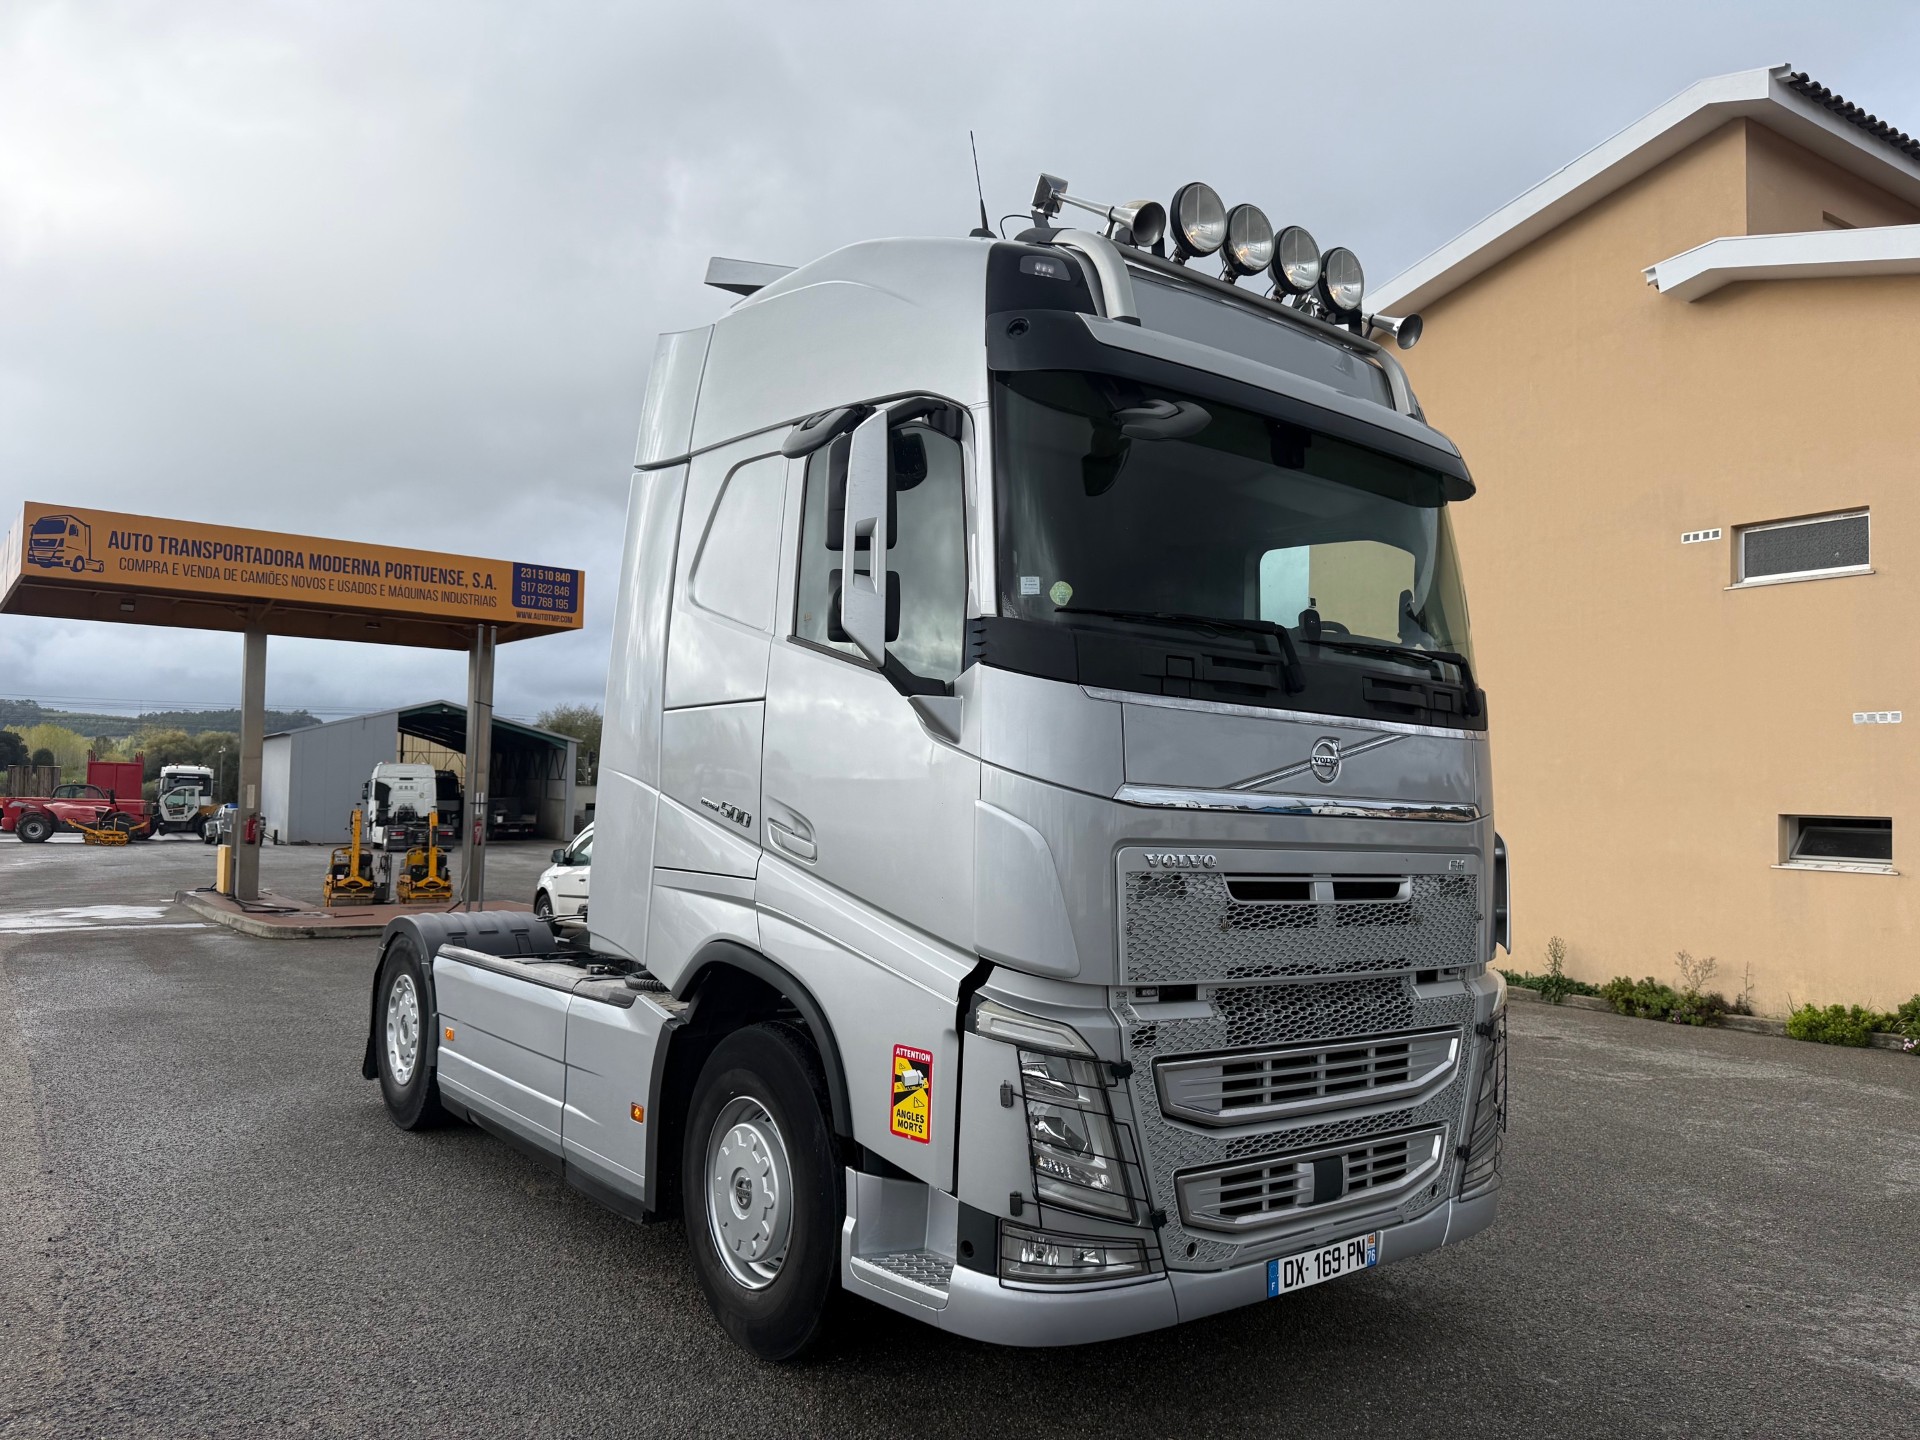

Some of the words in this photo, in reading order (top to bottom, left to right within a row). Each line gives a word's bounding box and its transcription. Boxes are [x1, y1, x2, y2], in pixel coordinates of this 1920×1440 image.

[108, 530, 153, 552] AUTO
[158, 536, 305, 570] TRANSPORTADORA
[309, 553, 381, 577] MODERNA
[385, 562, 469, 588] PORTUENSE,
[472, 572, 497, 590] S.A.
[119, 557, 168, 574] COMPRA
[172, 562, 179, 576] E
[182, 564, 220, 580] VENDA
[223, 569, 238, 582] DE
[240, 569, 289, 587] CAMIÕES
[291, 575, 326, 591] NOVOS
[329, 578, 335, 591] E
[337, 580, 377, 596] USADOS
[380, 584, 386, 597] E
[388, 584, 439, 602] MÁQUINAS
[441, 591, 497, 608] INDUSTRIAIS
[521, 568, 537, 579] 231
[538, 570, 554, 581] 510
[555, 572, 571, 583] 840
[521, 581, 536, 592] 917
[537, 583, 553, 595] 822
[554, 585, 570, 597] 846
[521, 595, 536, 606] 917
[537, 597, 553, 608] 768
[555, 599, 569, 610] 195
[720, 801, 752, 828] 500
[1144, 853, 1217, 869] VOLVO
[896, 1048, 930, 1061] ATTENTION
[896, 1109, 924, 1124] ANGLES
[897, 1119, 922, 1133] MORTS
[1367, 1249, 1376, 1263] 76
[1271, 1281, 1276, 1291] F
